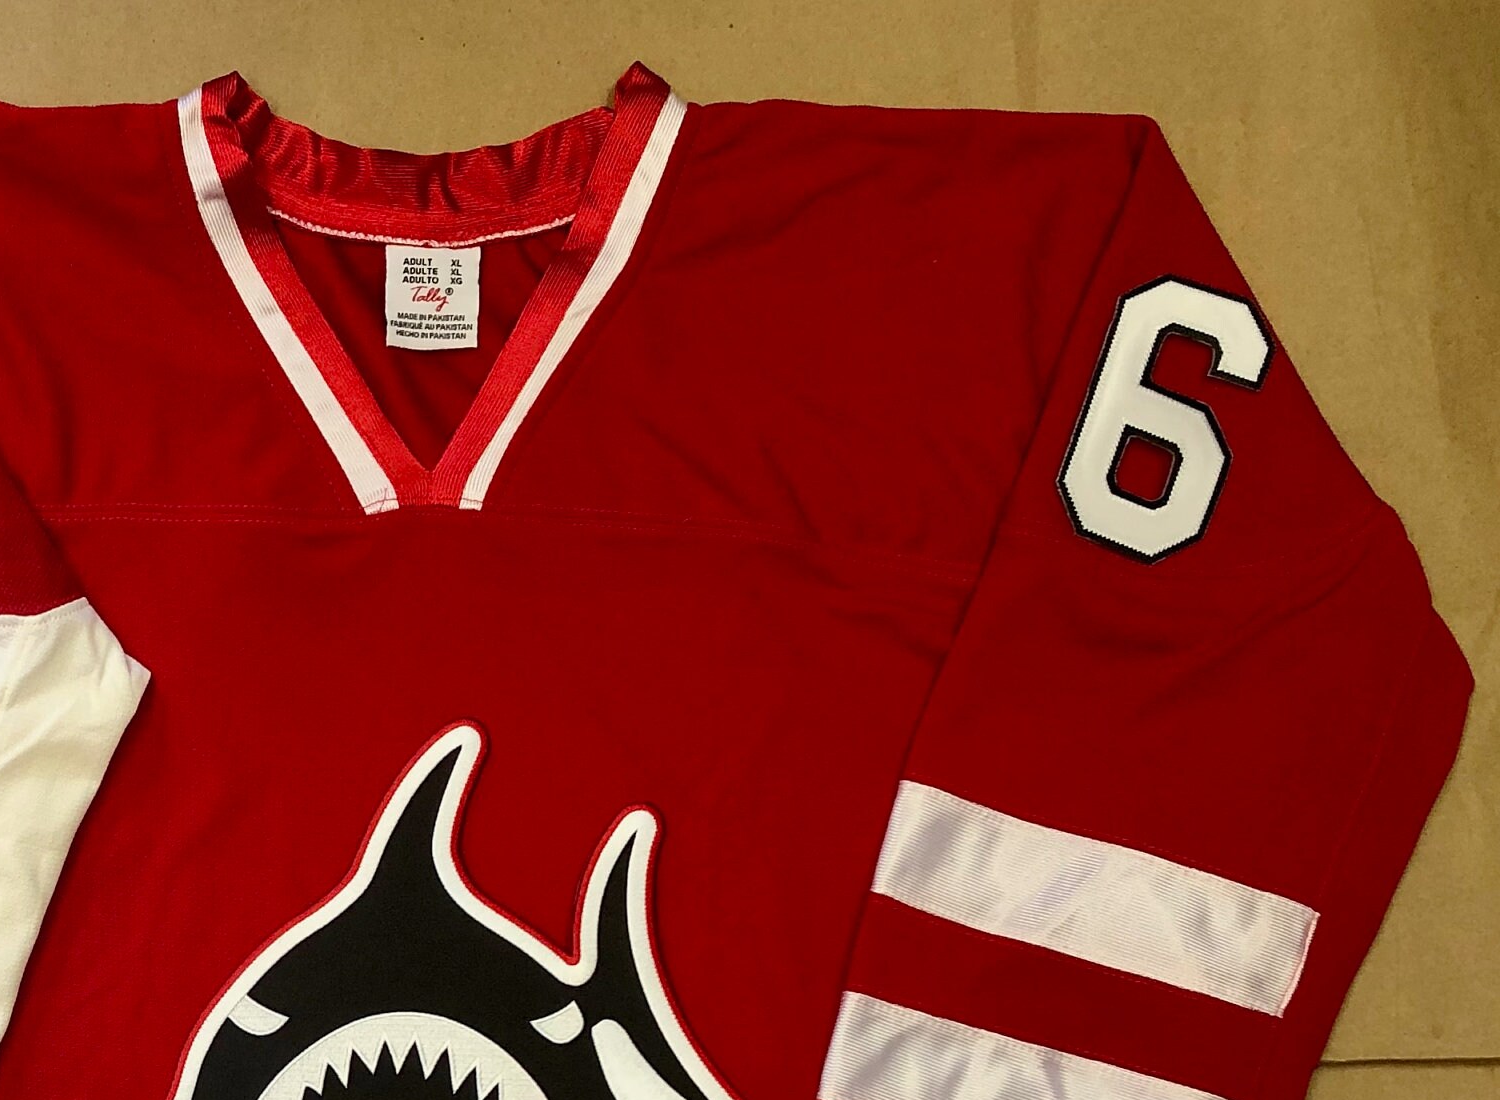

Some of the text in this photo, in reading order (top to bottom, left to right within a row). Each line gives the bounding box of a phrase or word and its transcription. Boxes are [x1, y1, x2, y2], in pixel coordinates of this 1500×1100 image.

[403, 257, 462, 267] ADULT XL
[402, 267, 462, 276] ADULTE XL
[402, 275, 463, 285] ADULTO XG
[397, 312, 418, 320] MADE
[427, 314, 465, 322] PAKISTAN
[435, 323, 473, 331] PAKISTAN
[396, 329, 419, 339] HECHO
[429, 332, 467, 340] PAKISTAN
[1056, 274, 1276, 564] 6
